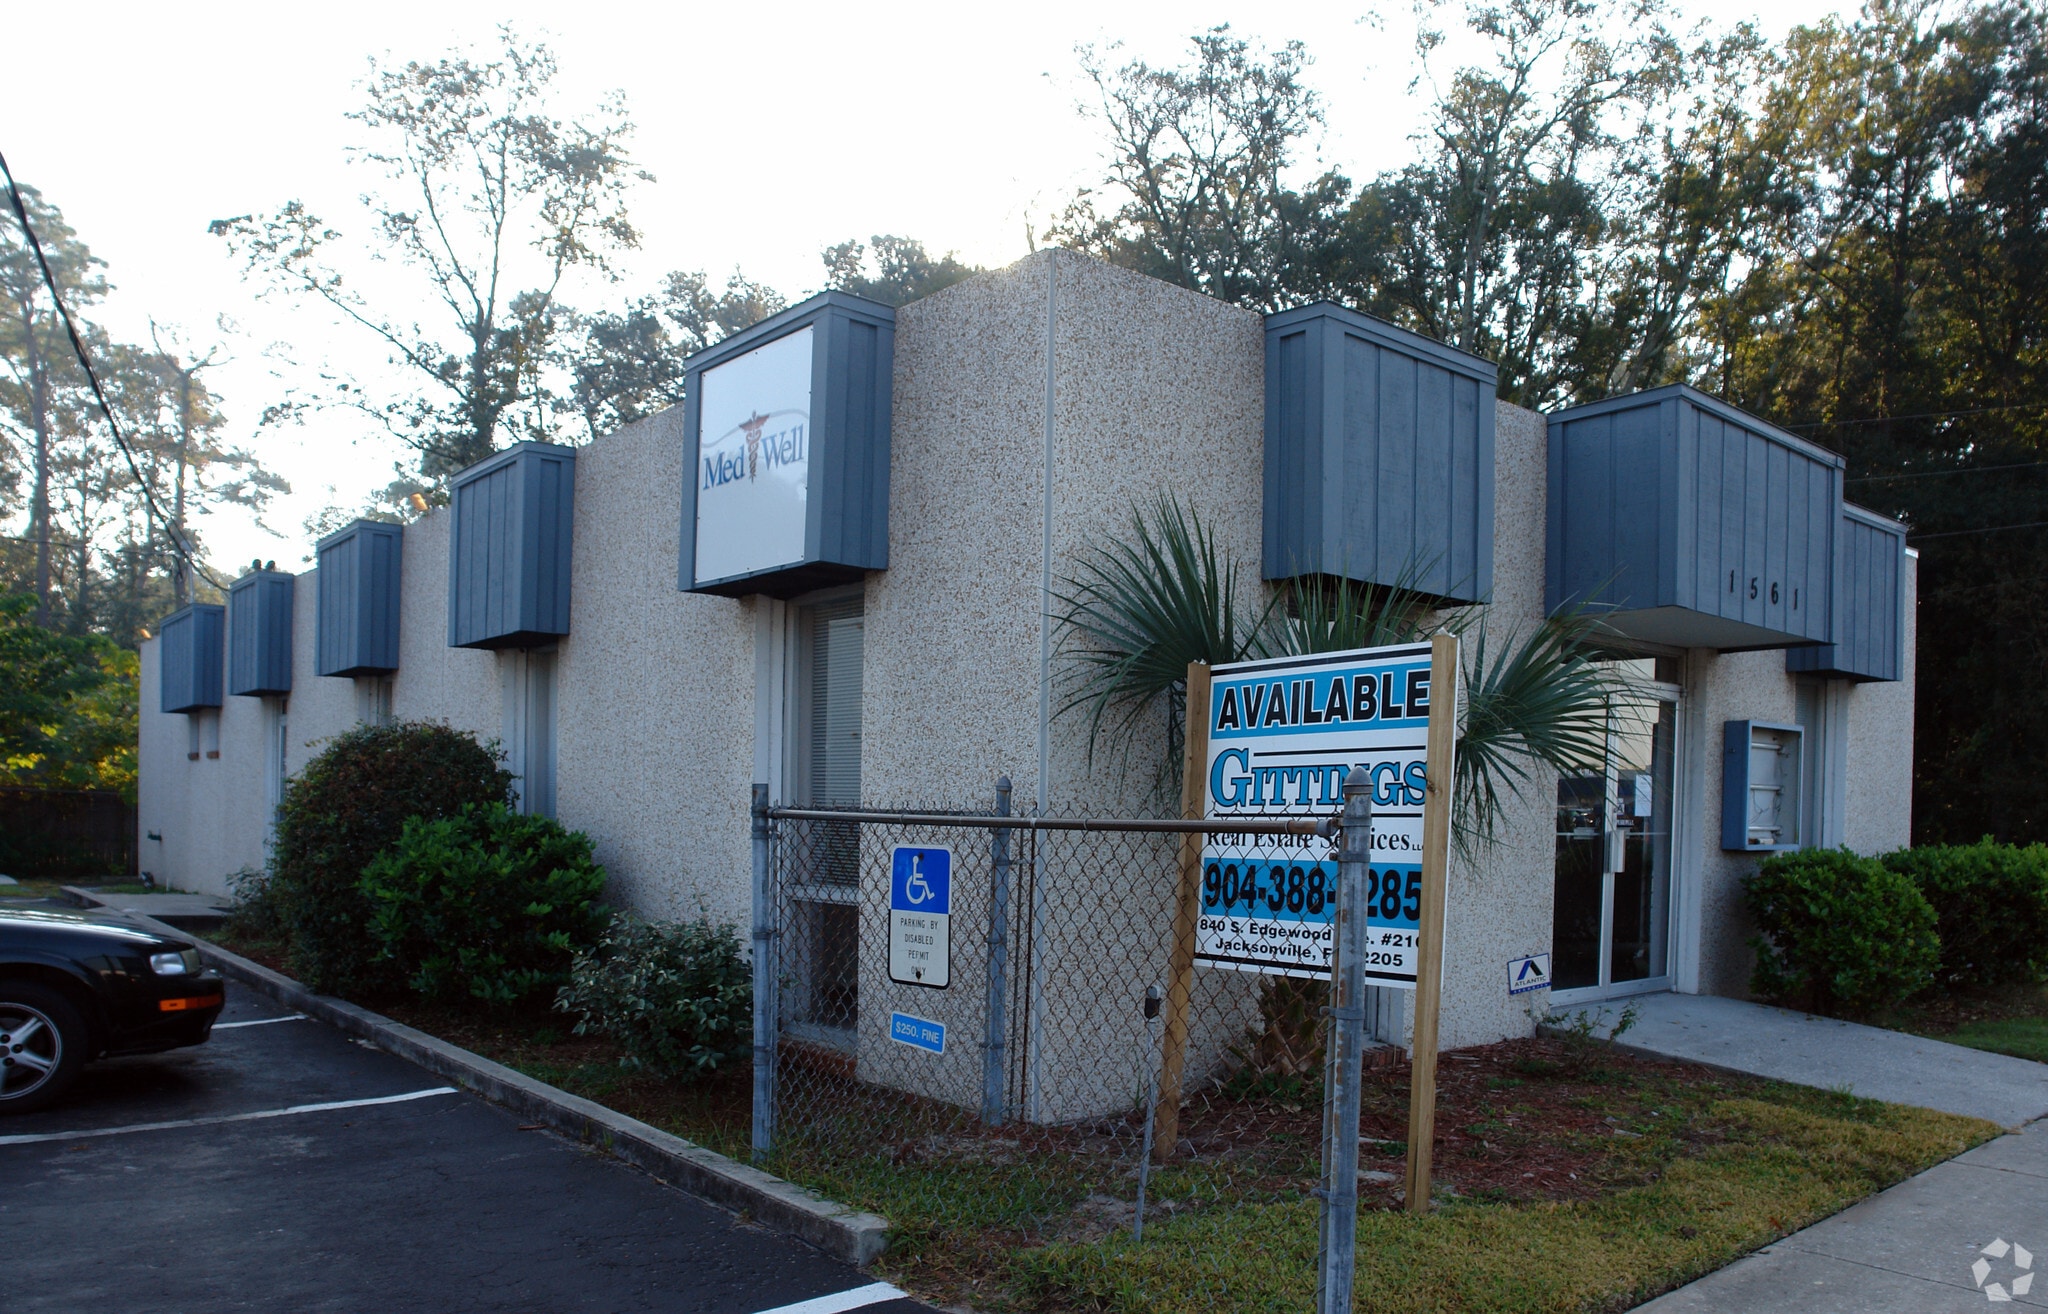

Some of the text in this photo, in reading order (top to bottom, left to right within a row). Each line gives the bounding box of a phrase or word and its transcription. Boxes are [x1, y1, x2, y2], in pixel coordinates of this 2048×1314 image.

[703, 423, 804, 491] Med Well
[1730, 569, 1798, 610] 1561
[1217, 668, 1430, 732] AVAILABLE
[1320, 828, 1410, 851] Seices
[1204, 863, 1421, 921] 904-388-285
[900, 917, 939, 930] PARKING BY
[1200, 919, 1226, 932] 840
[1230, 921, 1244, 934] S.
[1249, 923, 1332, 942] Edgewood
[904, 933, 934, 946] DISABLED
[1215, 938, 1317, 961] Jacksonville,
[1365, 952, 1403, 967] 205
[895, 1021, 940, 1044] $250. FINE
